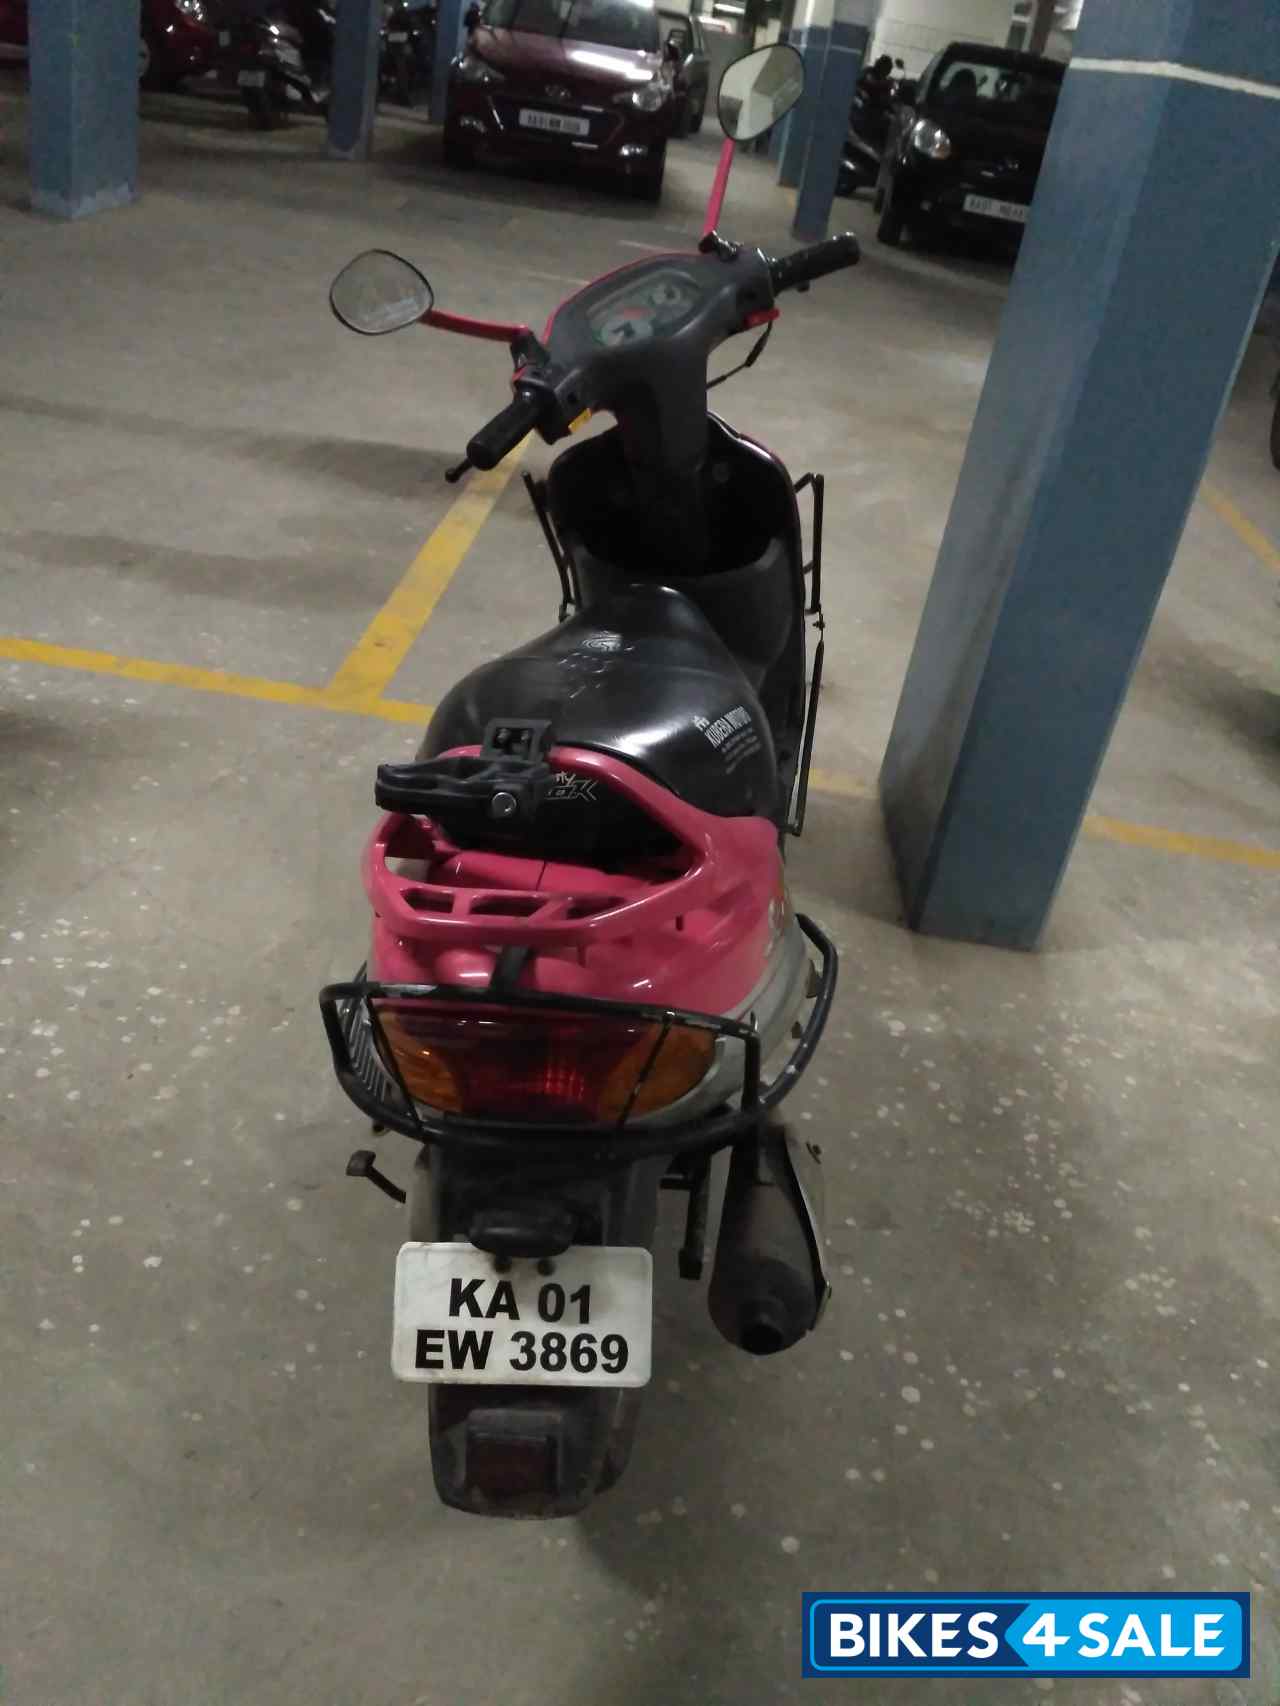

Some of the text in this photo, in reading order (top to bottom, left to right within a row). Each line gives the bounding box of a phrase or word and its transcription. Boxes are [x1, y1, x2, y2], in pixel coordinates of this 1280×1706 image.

[449, 1278, 591, 1324] KA 01
[415, 1329, 629, 1373] EW 3869
